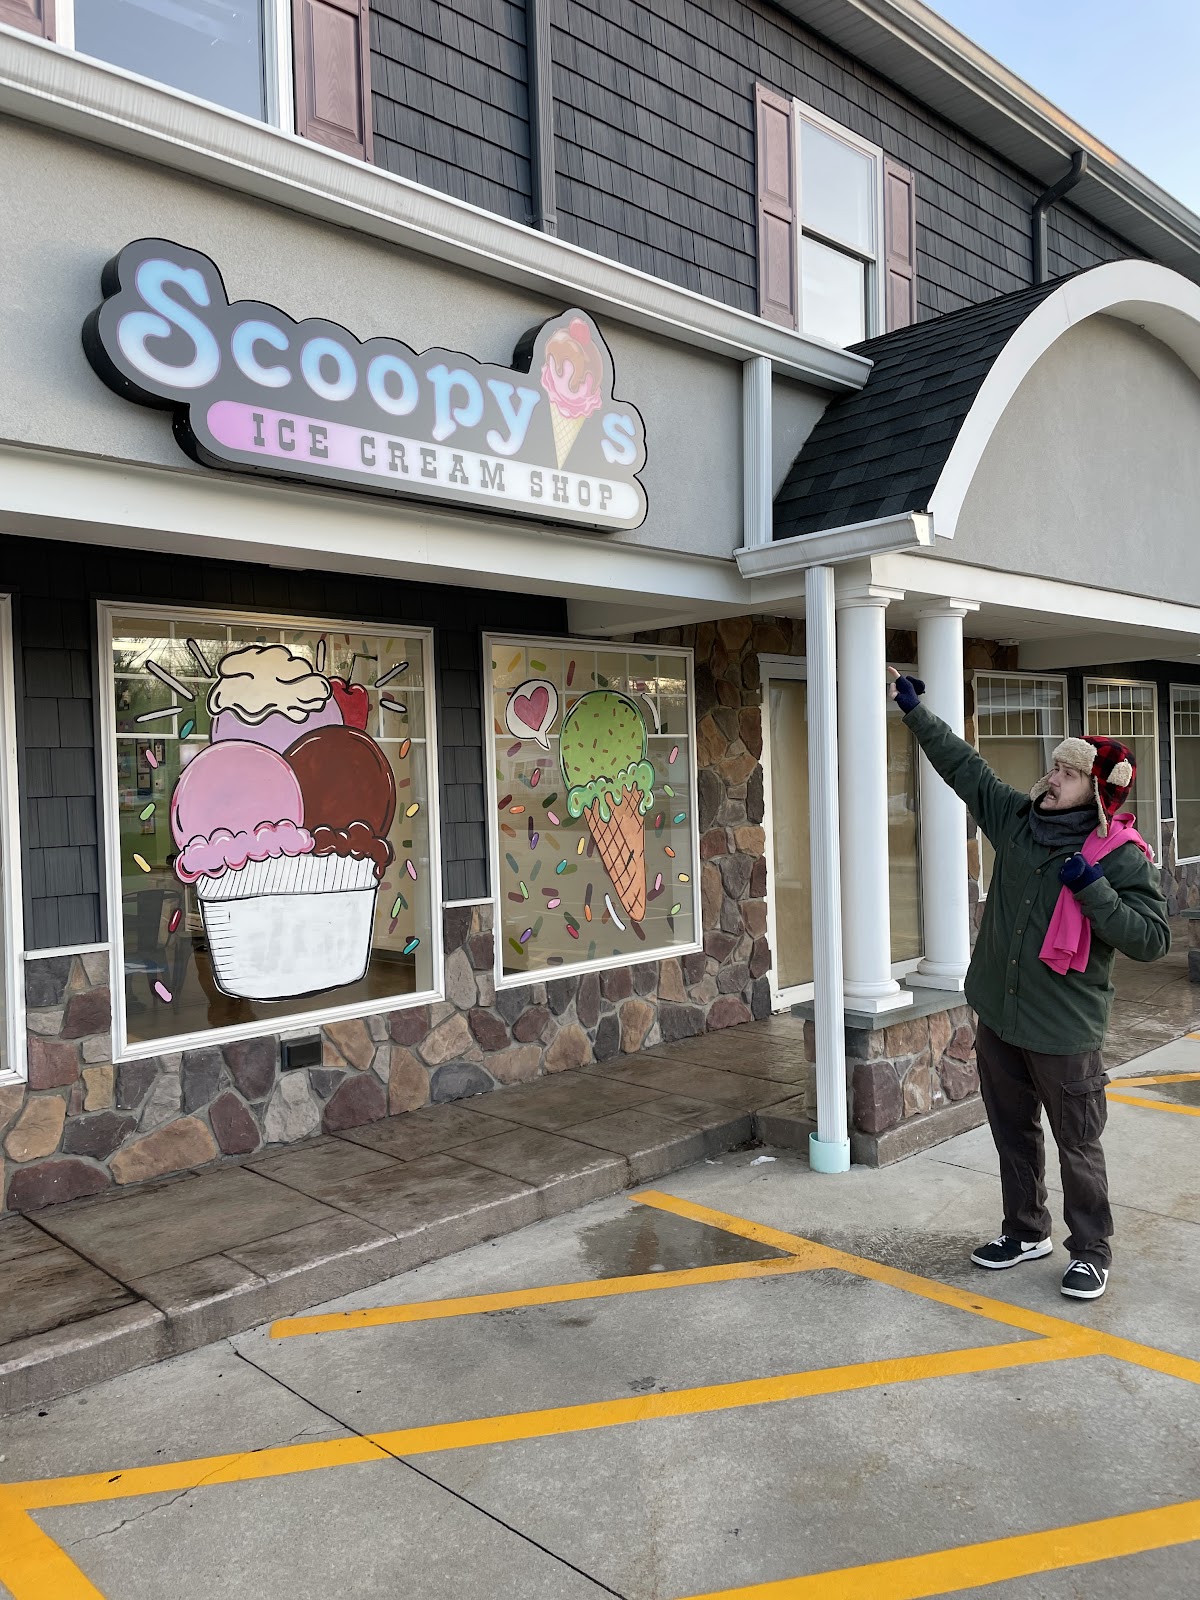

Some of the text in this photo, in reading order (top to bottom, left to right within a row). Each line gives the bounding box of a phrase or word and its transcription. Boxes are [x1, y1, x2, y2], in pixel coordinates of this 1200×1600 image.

[252, 412, 613, 511] ICE CREAM SHOP
